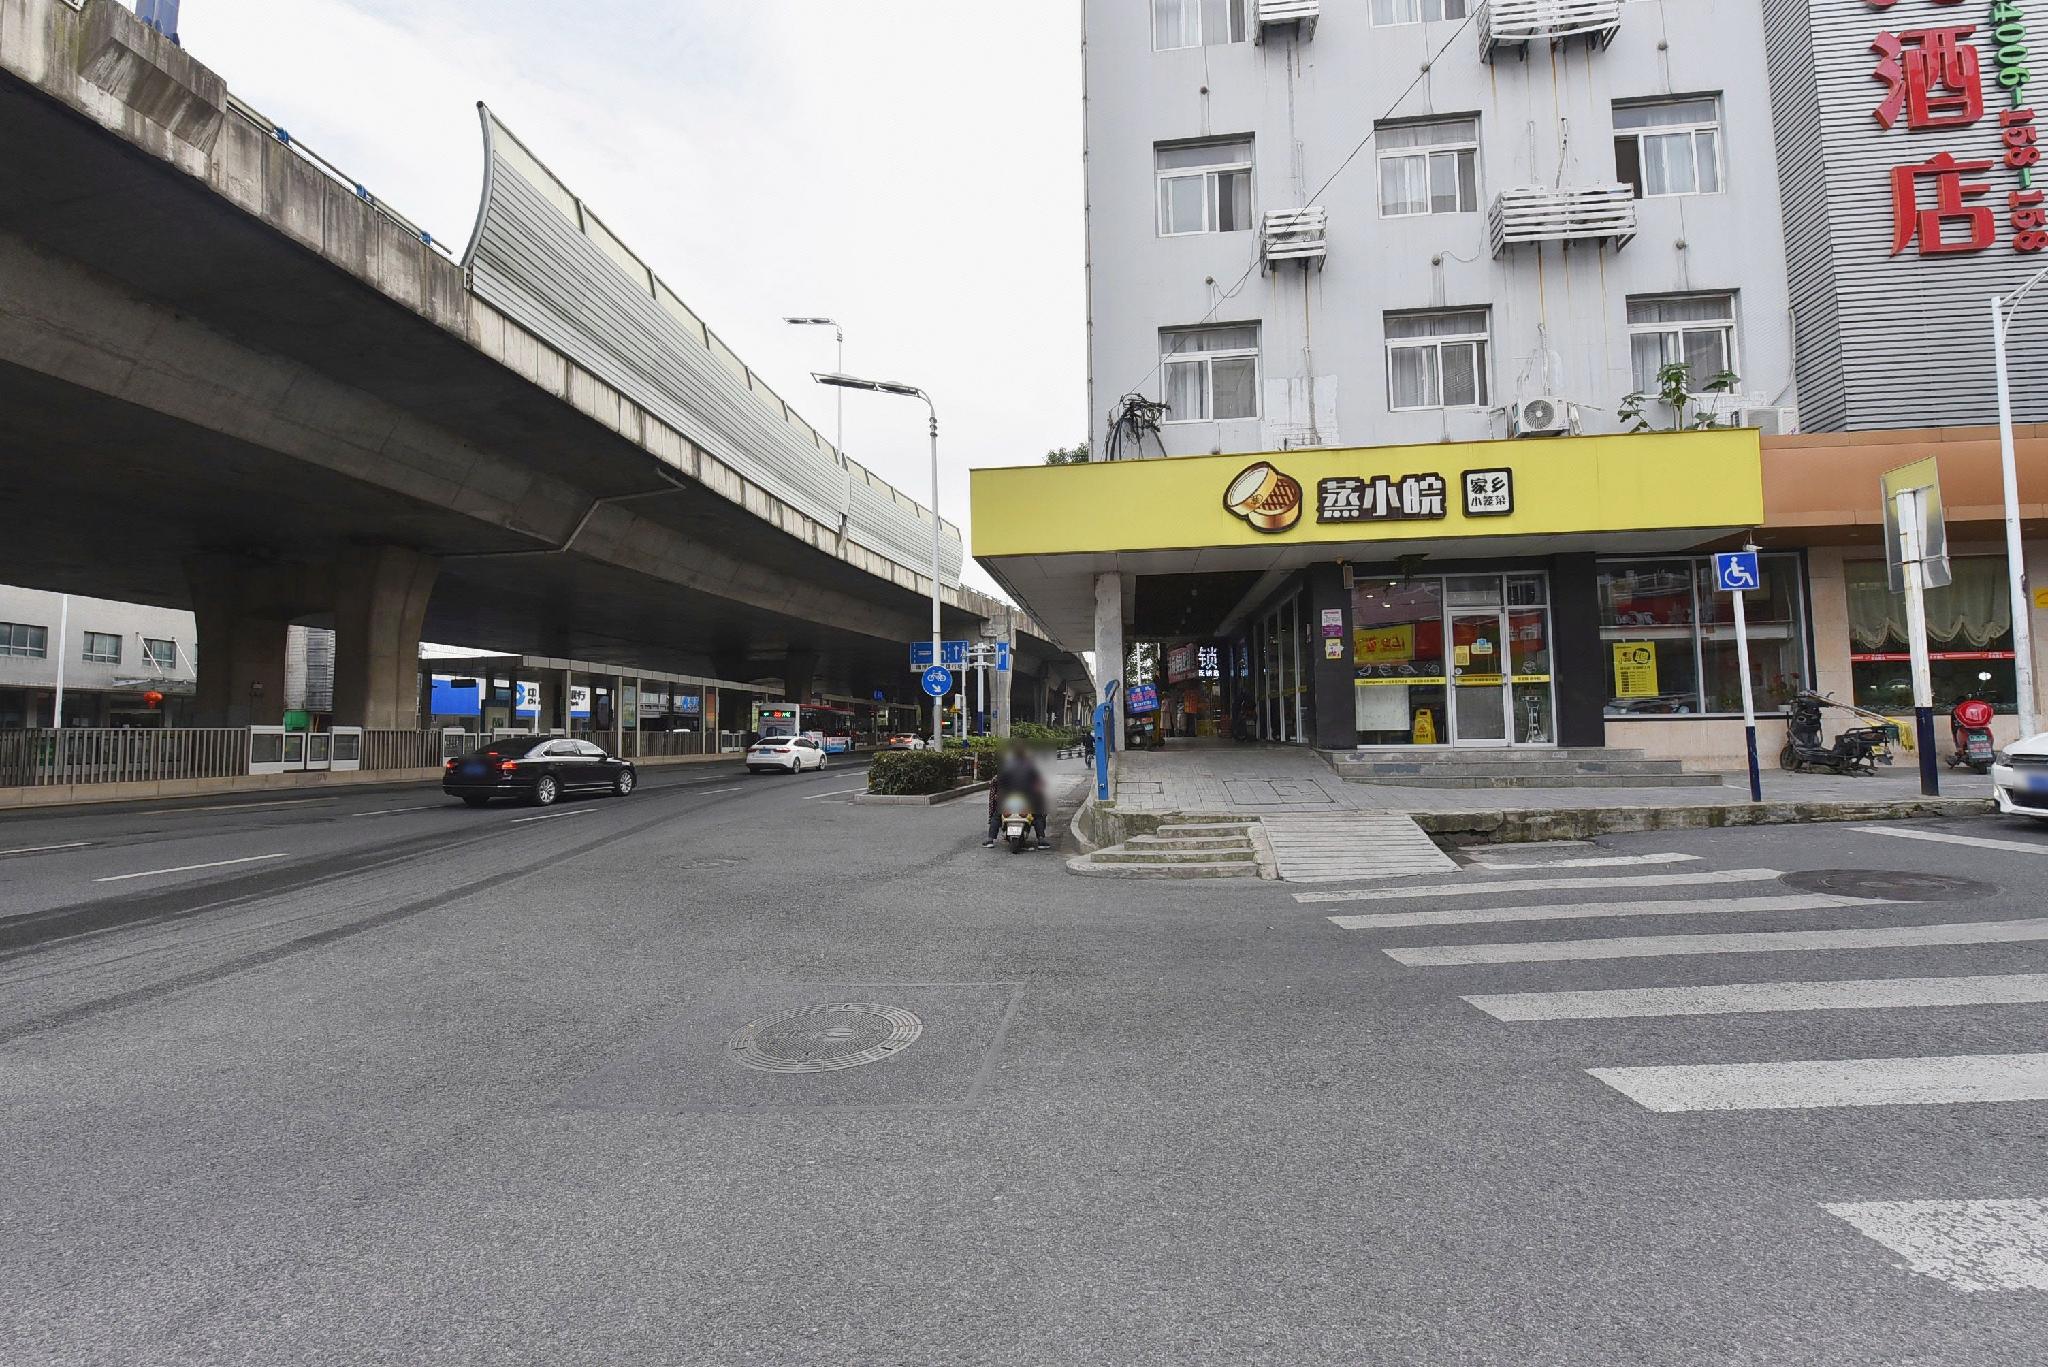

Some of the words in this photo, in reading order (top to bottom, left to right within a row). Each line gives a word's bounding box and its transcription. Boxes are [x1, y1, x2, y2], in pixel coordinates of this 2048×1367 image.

[1869, 24, 1996, 258] 酒店
[1470, 476, 1506, 494] 家乡
[1197, 646, 1218, 669] 锁
